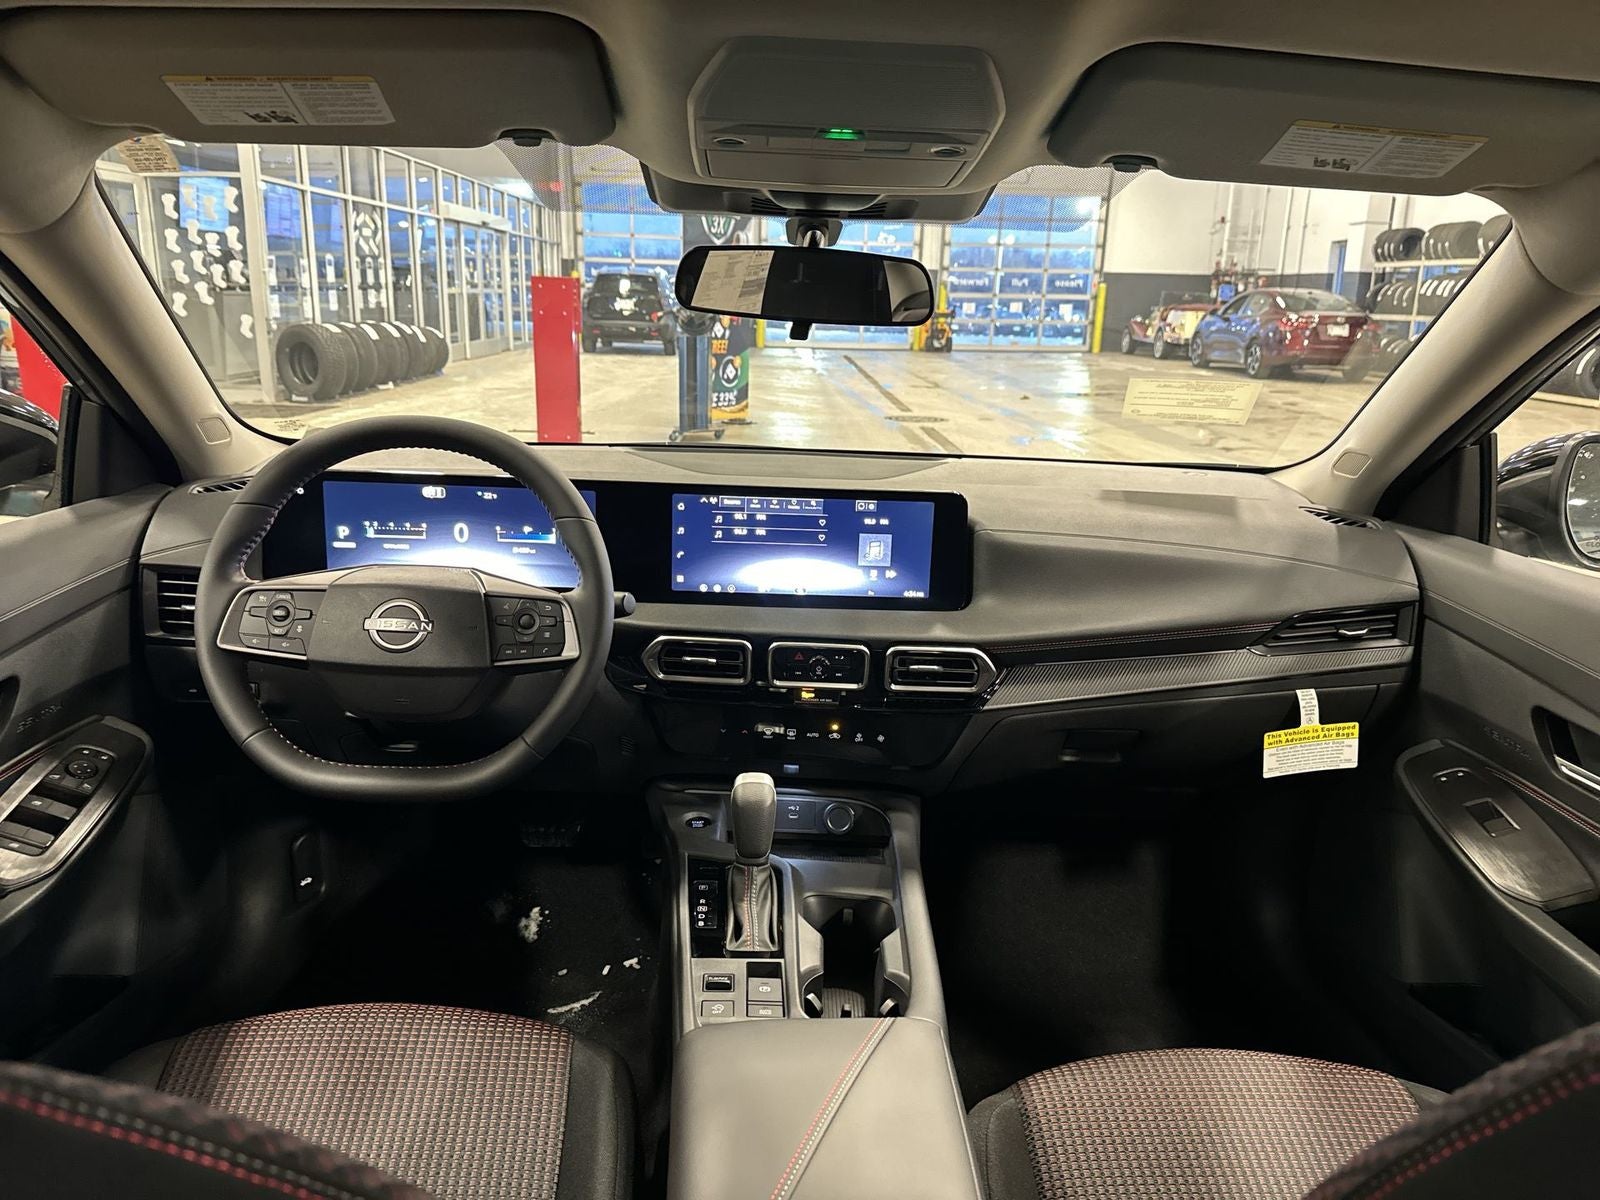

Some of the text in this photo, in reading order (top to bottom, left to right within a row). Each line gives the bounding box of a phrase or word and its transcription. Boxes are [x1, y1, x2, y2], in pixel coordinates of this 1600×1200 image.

[710, 216, 727, 235] 3X
[711, 339, 729, 354] REE!
[336, 525, 350, 540] P
[453, 522, 469, 543] 0
[367, 618, 433, 632] NISSAN
[1284, 729, 1310, 737] Vehicle
[1321, 724, 1356, 734] Equipped
[1267, 739, 1283, 747] with
[1285, 735, 1320, 744] Advanced
